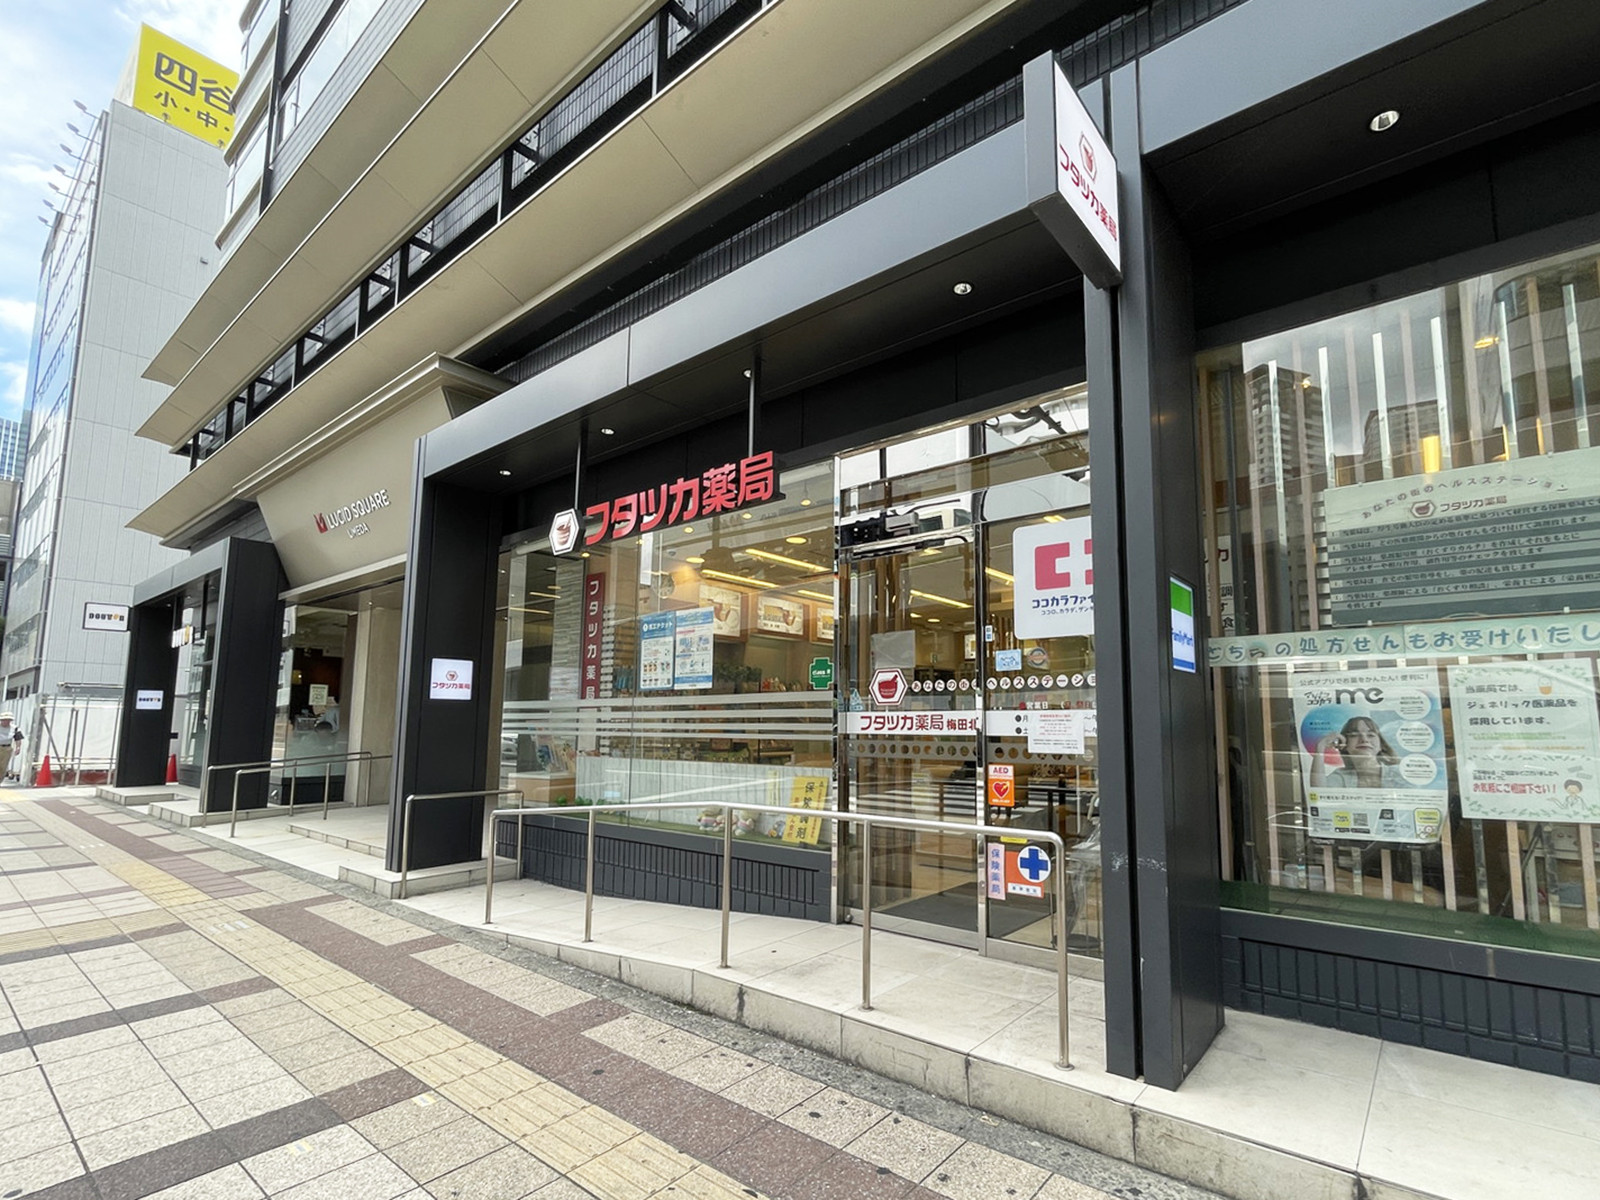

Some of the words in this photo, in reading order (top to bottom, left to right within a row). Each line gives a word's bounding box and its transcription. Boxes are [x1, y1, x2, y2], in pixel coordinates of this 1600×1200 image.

[154, 51, 236, 116] 四谷
[1058, 143, 1118, 242] フタツカ薬局
[585, 450, 774, 546] フタツカ薬局
[1440, 495, 1508, 513] フタツカ薬局
[325, 505, 353, 529] LUCID
[350, 488, 390, 518] SQUARE
[346, 521, 370, 539] UMEDA
[88, 612, 125, 622] DOUTOR
[586, 580, 600, 700] フタツカ薬局
[432, 682, 471, 690] フタツカ薬局
[1335, 687, 1384, 704] me
[860, 714, 944, 731] フタツカ薬局
[992, 766, 1009, 775] AED
